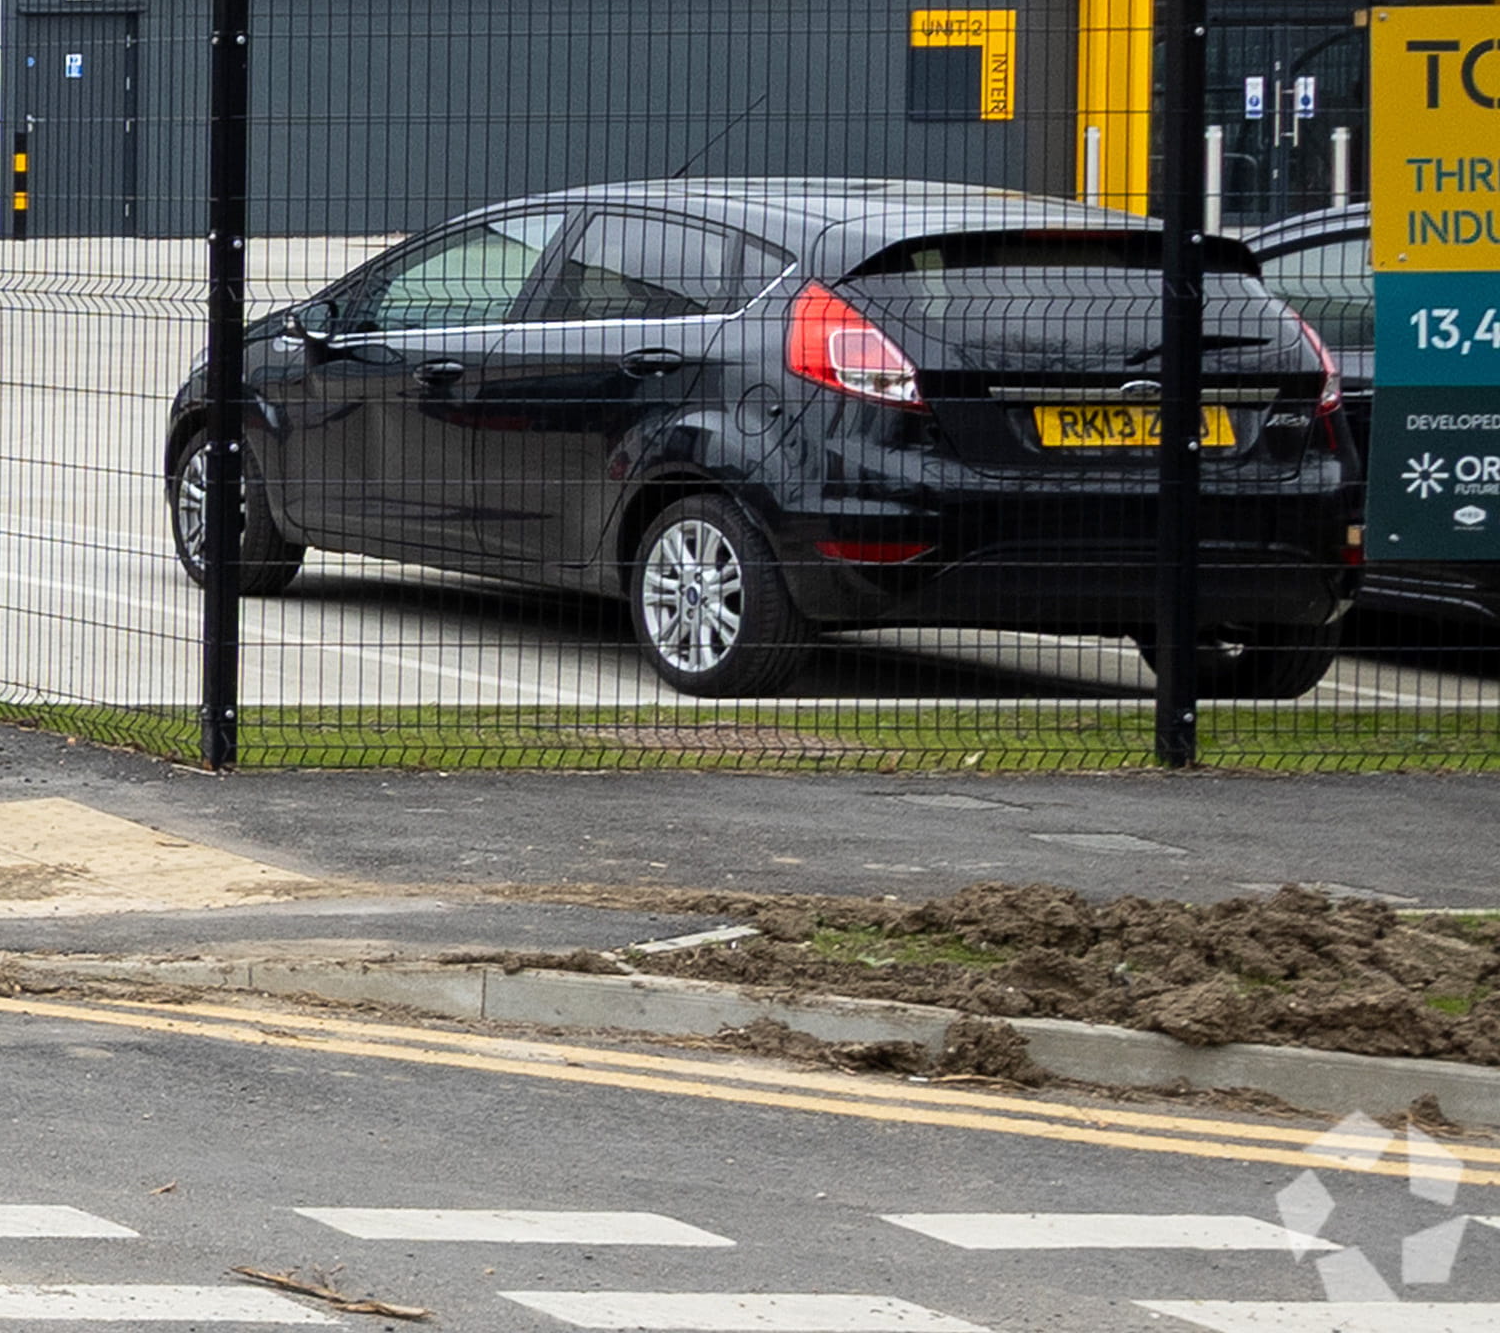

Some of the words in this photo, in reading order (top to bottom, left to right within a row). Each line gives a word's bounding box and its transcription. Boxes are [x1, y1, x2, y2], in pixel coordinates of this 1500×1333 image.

[922, 19, 967, 36] UNIT
[971, 19, 983, 36] 2
[991, 53, 1007, 113] INTER
[1406, 157, 1500, 193] THR
[1410, 308, 1500, 355] 13,4
[1058, 409, 1136, 440] RK13
[1406, 414, 1500, 431] DEVELOPED
[1455, 455, 1500, 482] OR
